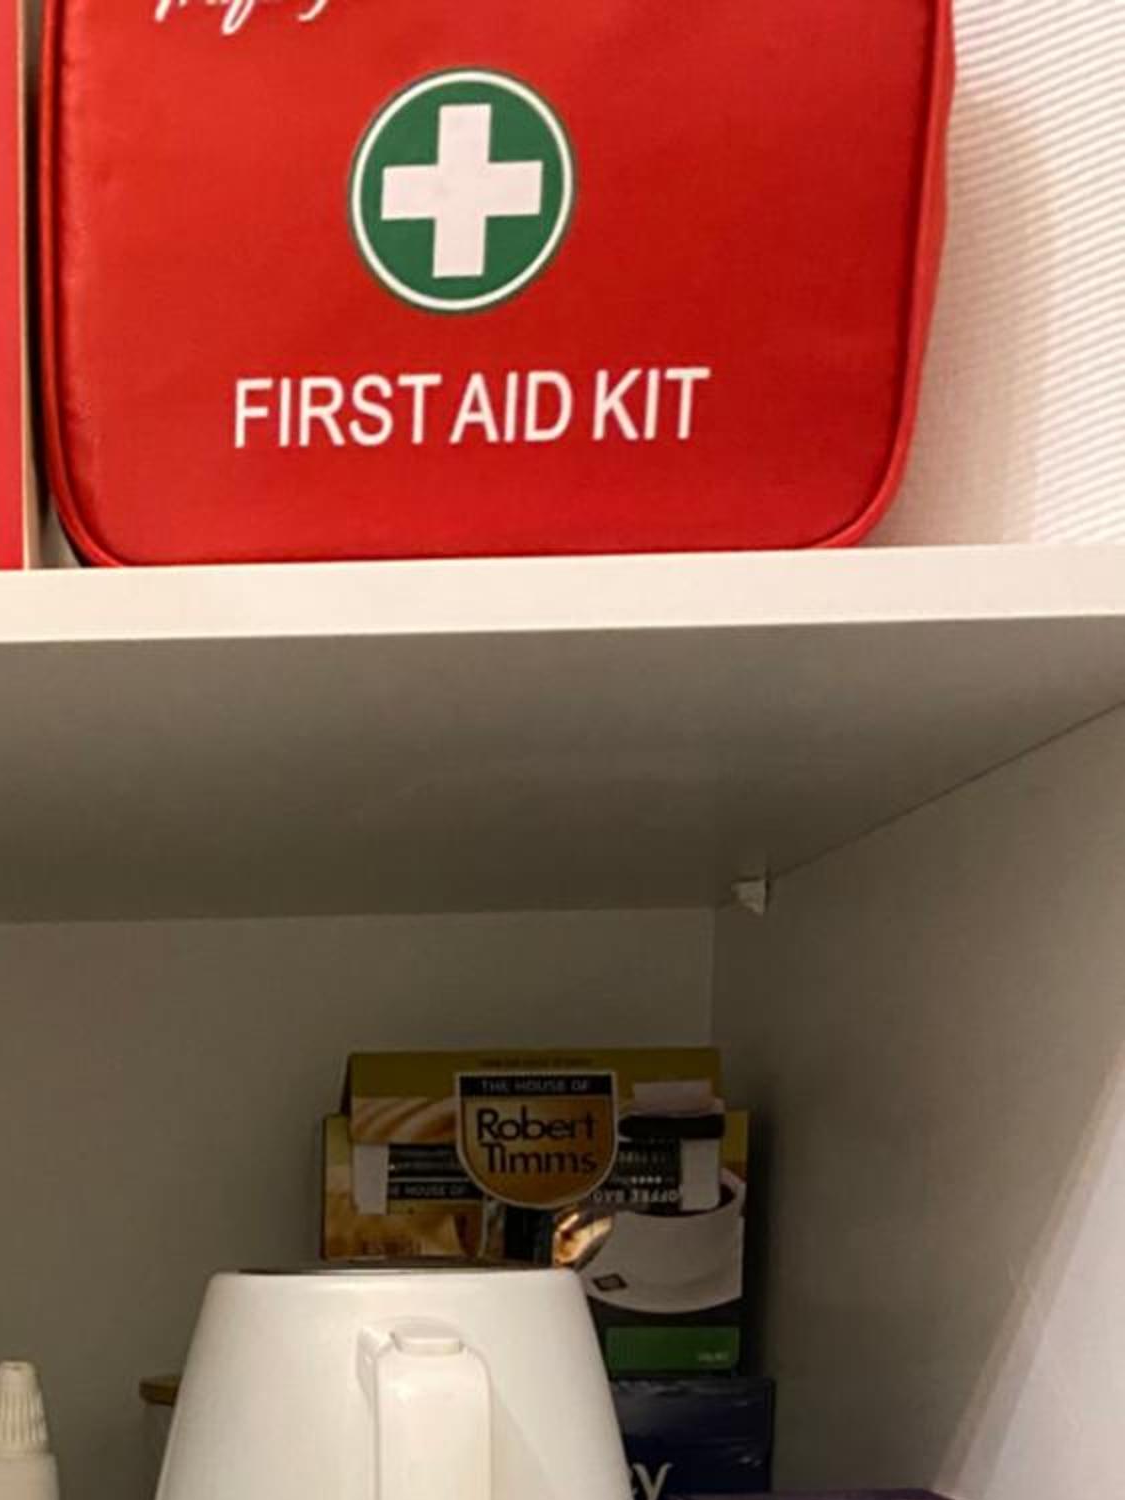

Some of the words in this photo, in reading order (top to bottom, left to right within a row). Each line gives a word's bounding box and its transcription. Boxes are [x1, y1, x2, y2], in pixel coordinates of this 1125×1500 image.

[233, 374, 442, 449] FIRST
[449, 368, 573, 445] AID
[592, 366, 711, 443] KIT
[481, 1080, 509, 1093] THE
[514, 1079, 567, 1093] HOUSE
[571, 1078, 591, 1092] OF
[476, 1105, 598, 1144] Robert
[478, 1140, 598, 1176] Timms
